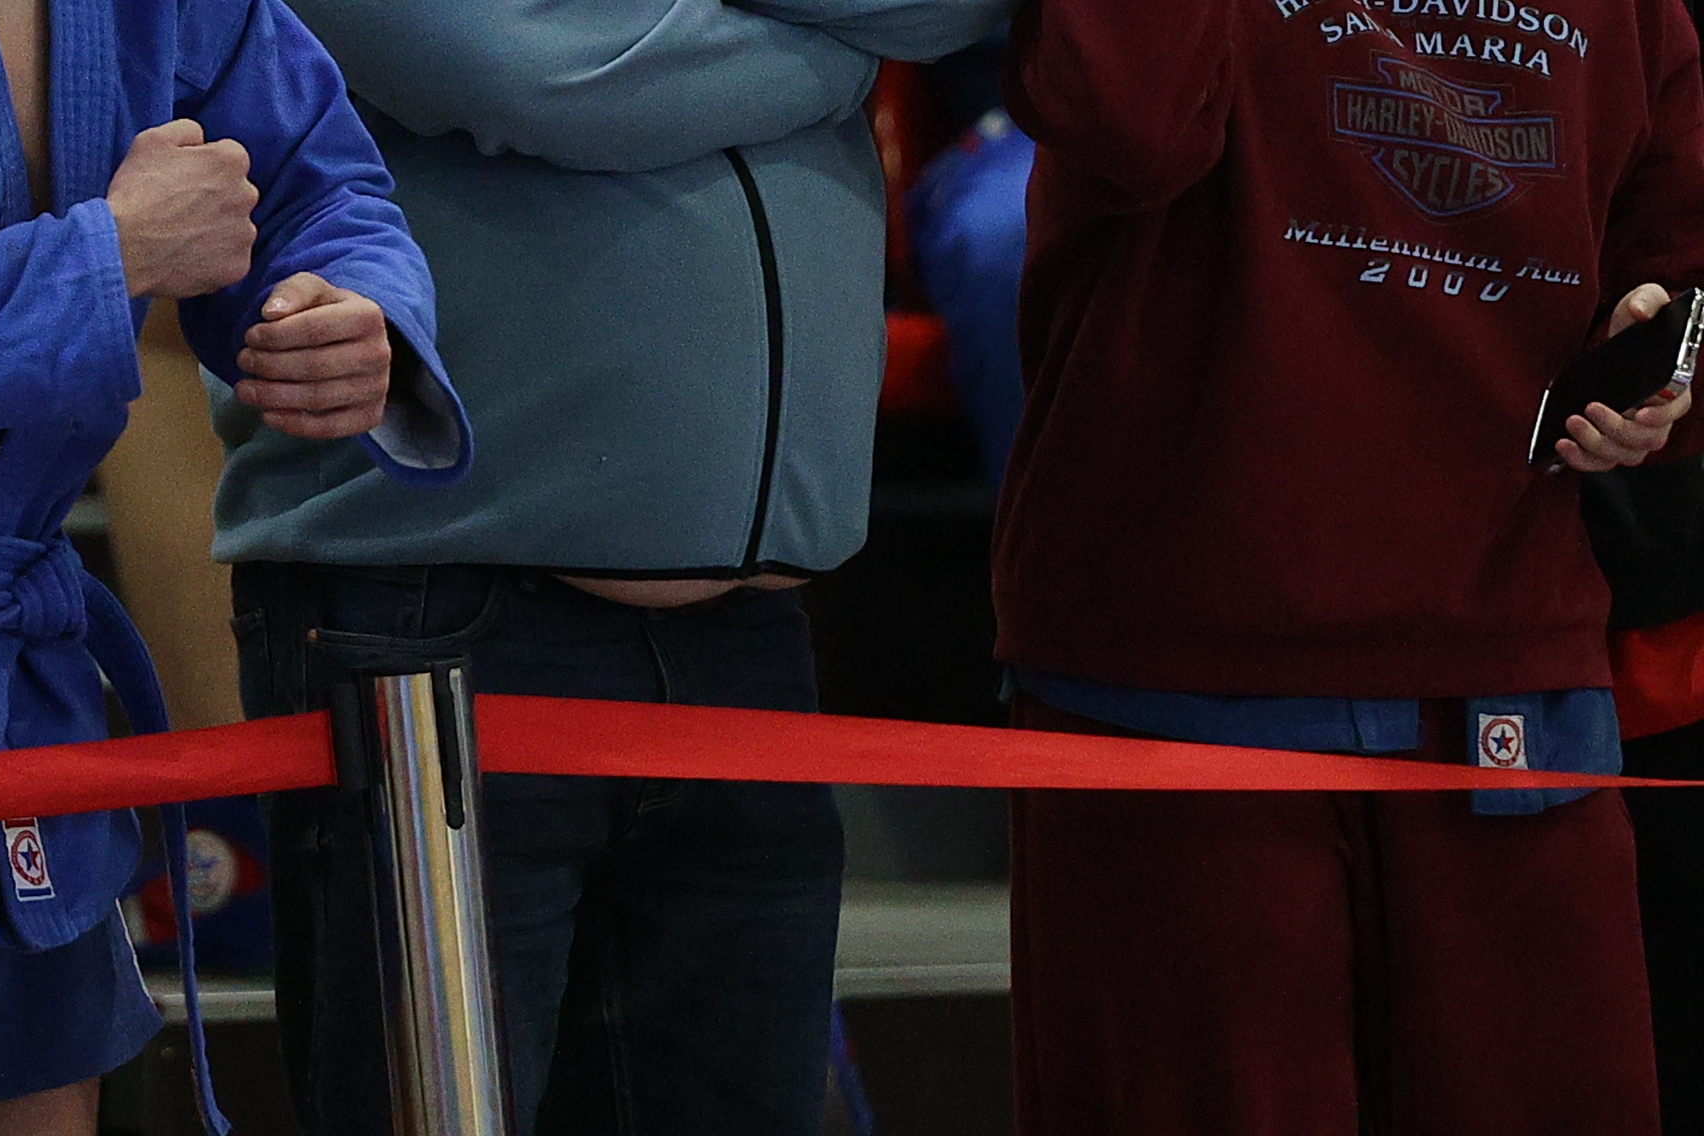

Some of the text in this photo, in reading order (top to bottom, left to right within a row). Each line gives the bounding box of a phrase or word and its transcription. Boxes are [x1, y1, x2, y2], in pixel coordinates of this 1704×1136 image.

[1319, 11, 1552, 77] SANA MARIA
[1346, 94, 1549, 162] HARLEY-DAVIDSON
[1391, 149, 1504, 208] CYCLES
[1359, 258, 1513, 303] 2000
